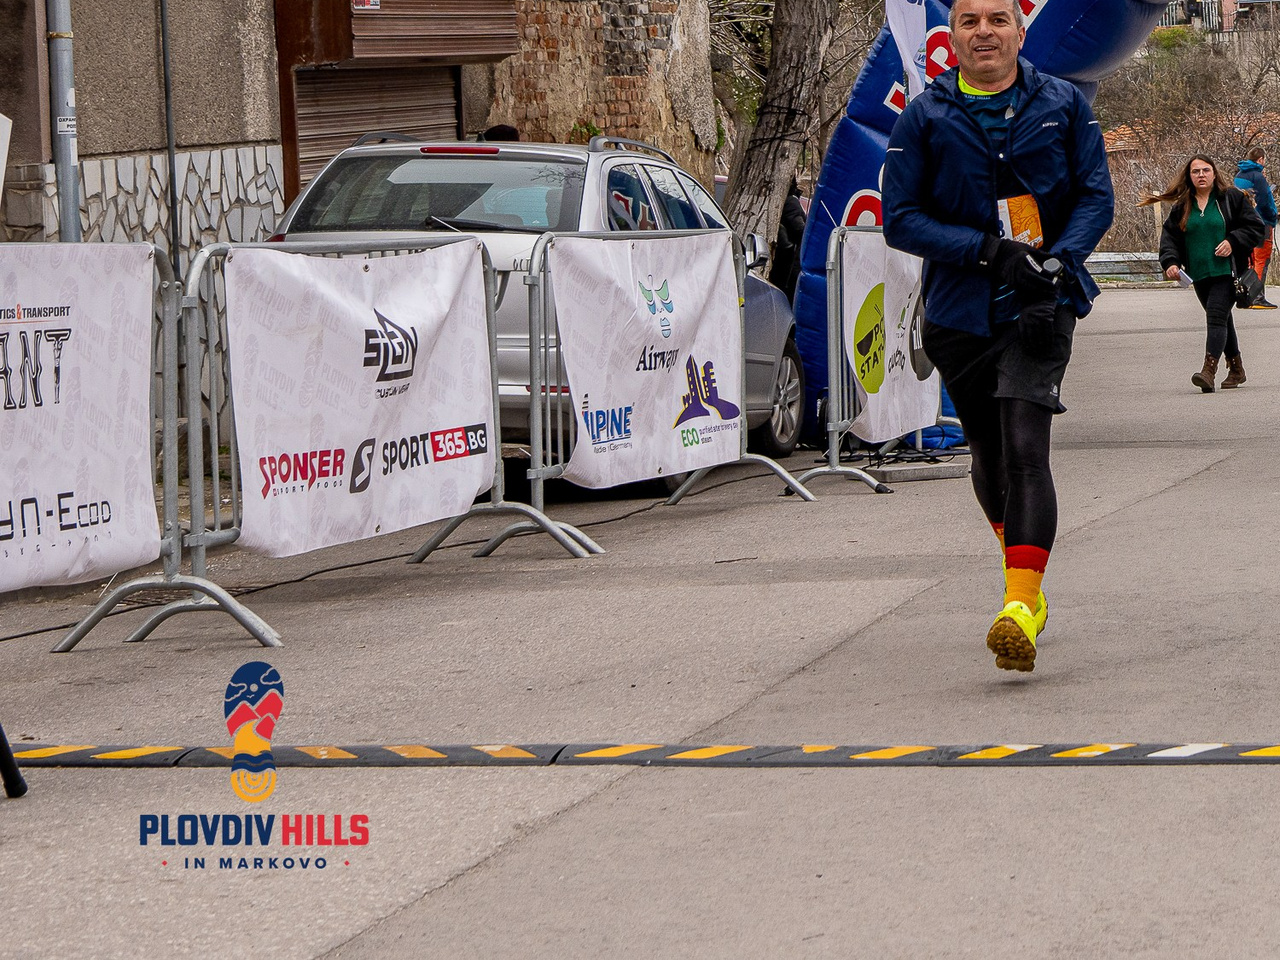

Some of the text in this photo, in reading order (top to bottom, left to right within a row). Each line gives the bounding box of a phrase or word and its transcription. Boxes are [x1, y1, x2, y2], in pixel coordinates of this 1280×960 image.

[636, 345, 680, 373] Airways
[680, 427, 700, 448] ECO
[258, 448, 346, 500] SPONSER
